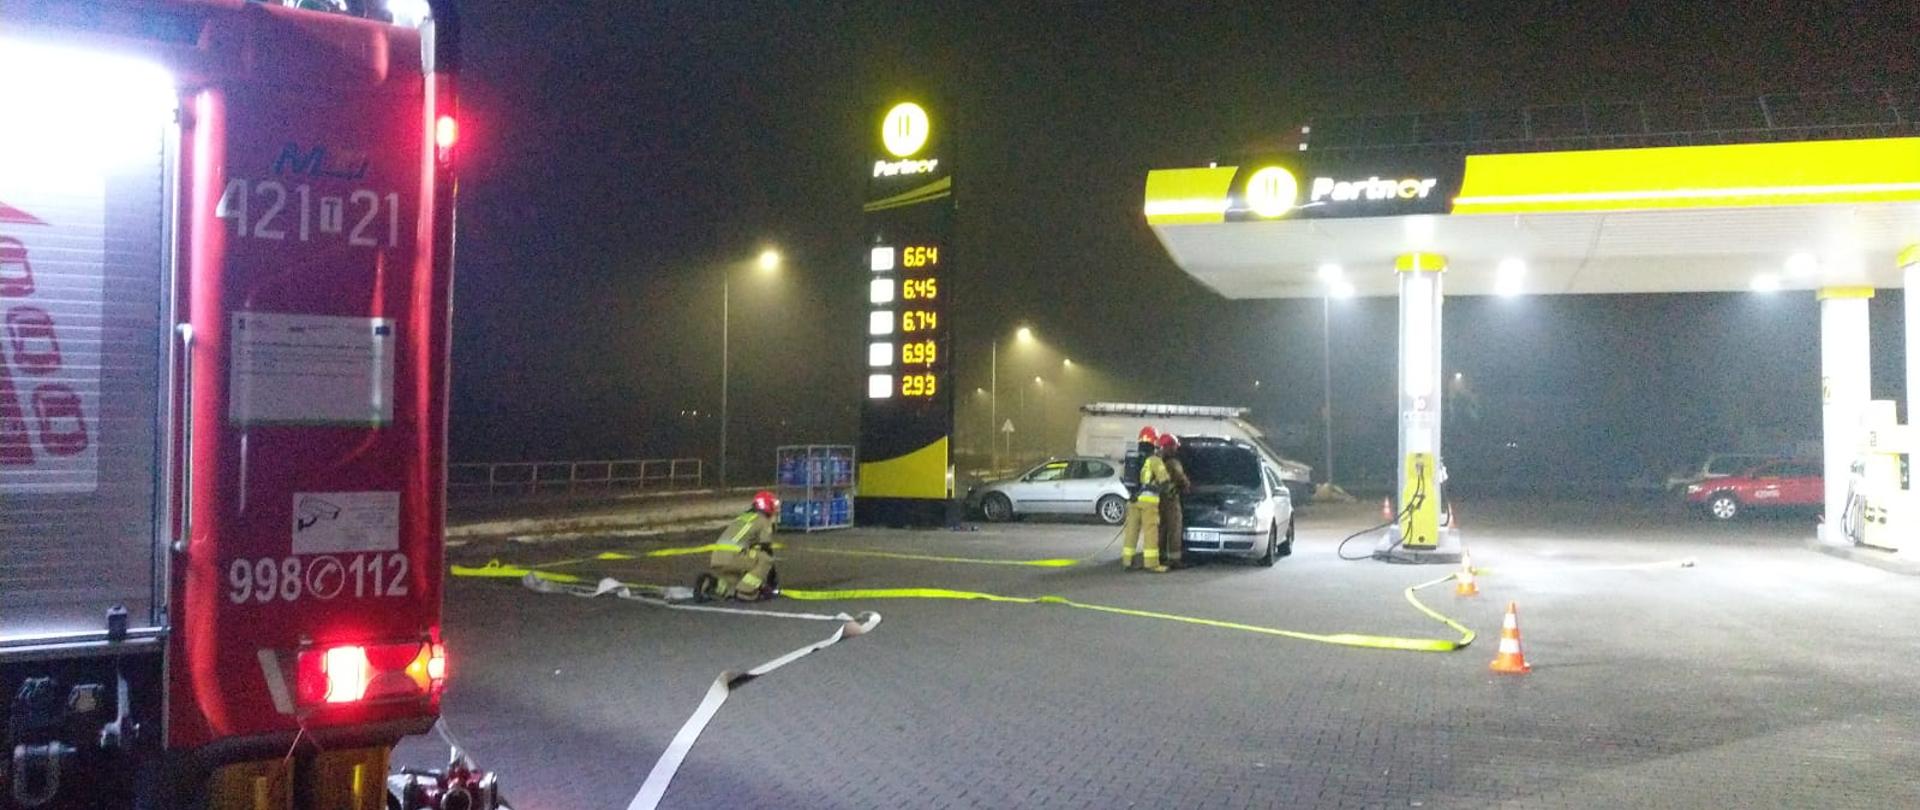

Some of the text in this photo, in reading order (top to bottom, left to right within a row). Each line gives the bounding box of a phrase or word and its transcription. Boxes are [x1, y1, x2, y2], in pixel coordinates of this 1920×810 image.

[903, 278, 937, 299] 6.45
[903, 311, 936, 331] 6.74
[230, 553, 408, 603] 998 112
